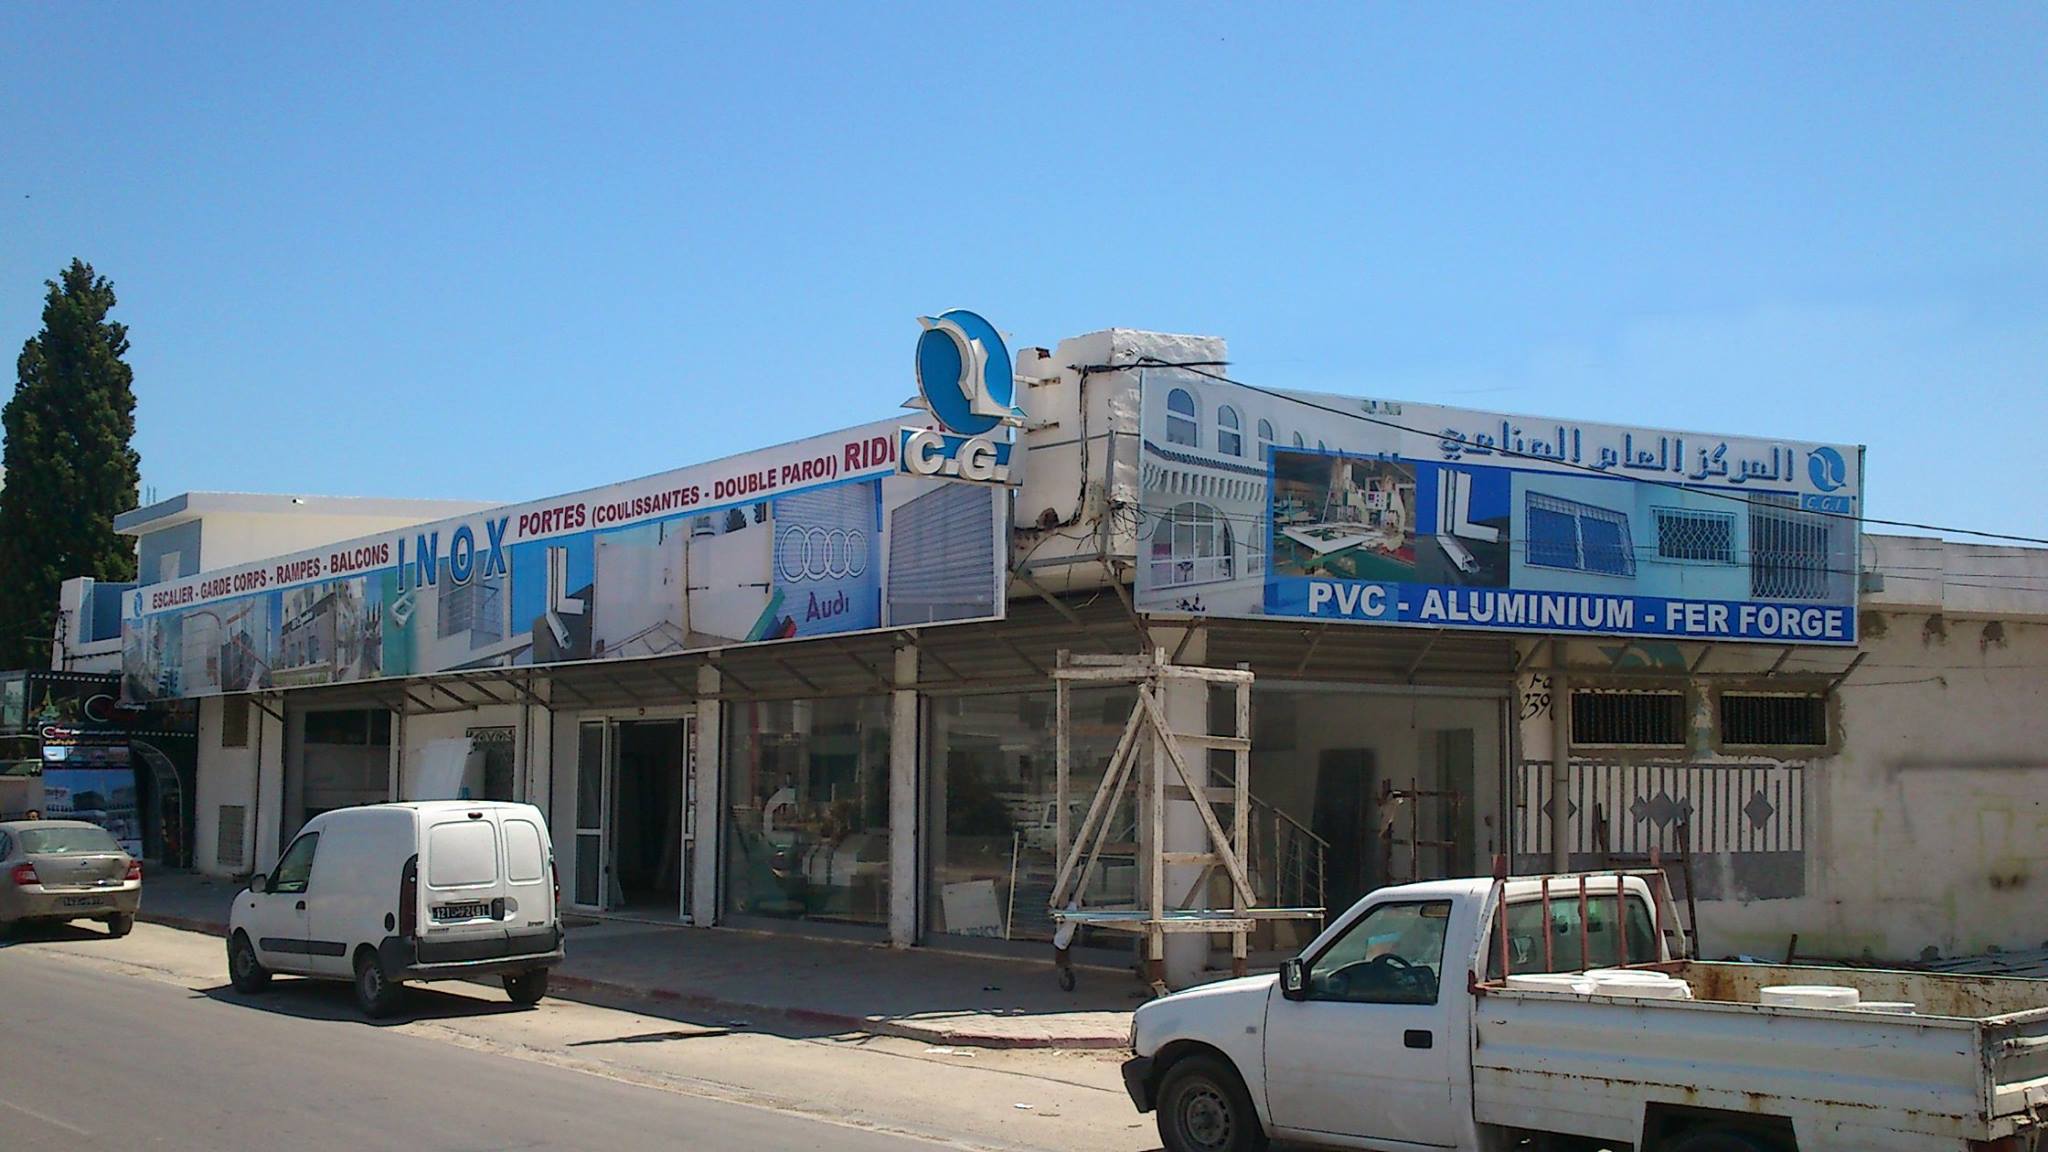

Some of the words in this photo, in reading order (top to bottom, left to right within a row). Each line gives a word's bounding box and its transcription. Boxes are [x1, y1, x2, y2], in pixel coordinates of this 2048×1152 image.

[1588, 432, 1685, 474] العام
[1689, 442, 1794, 484] المركز
[152, 585, 194, 610] ESCALIER
[200, 576, 232, 599] GARDE
[234, 570, 267, 591] CORPS
[276, 558, 321, 585] RAMPES
[330, 543, 389, 573] BALCONS
[397, 515, 511, 593] INOX
[518, 503, 586, 538] PORTES
[591, 485, 700, 528] (COULISSANTES
[714, 468, 777, 500] DOUBLE
[781, 454, 838, 486] PAROI)
[806, 590, 849, 622] Audi
[1308, 581, 1386, 617] PVC
[1419, 589, 1634, 629] ALUMINIUM
[1665, 602, 1729, 633] FER
[1738, 605, 1843, 638] FORGE
